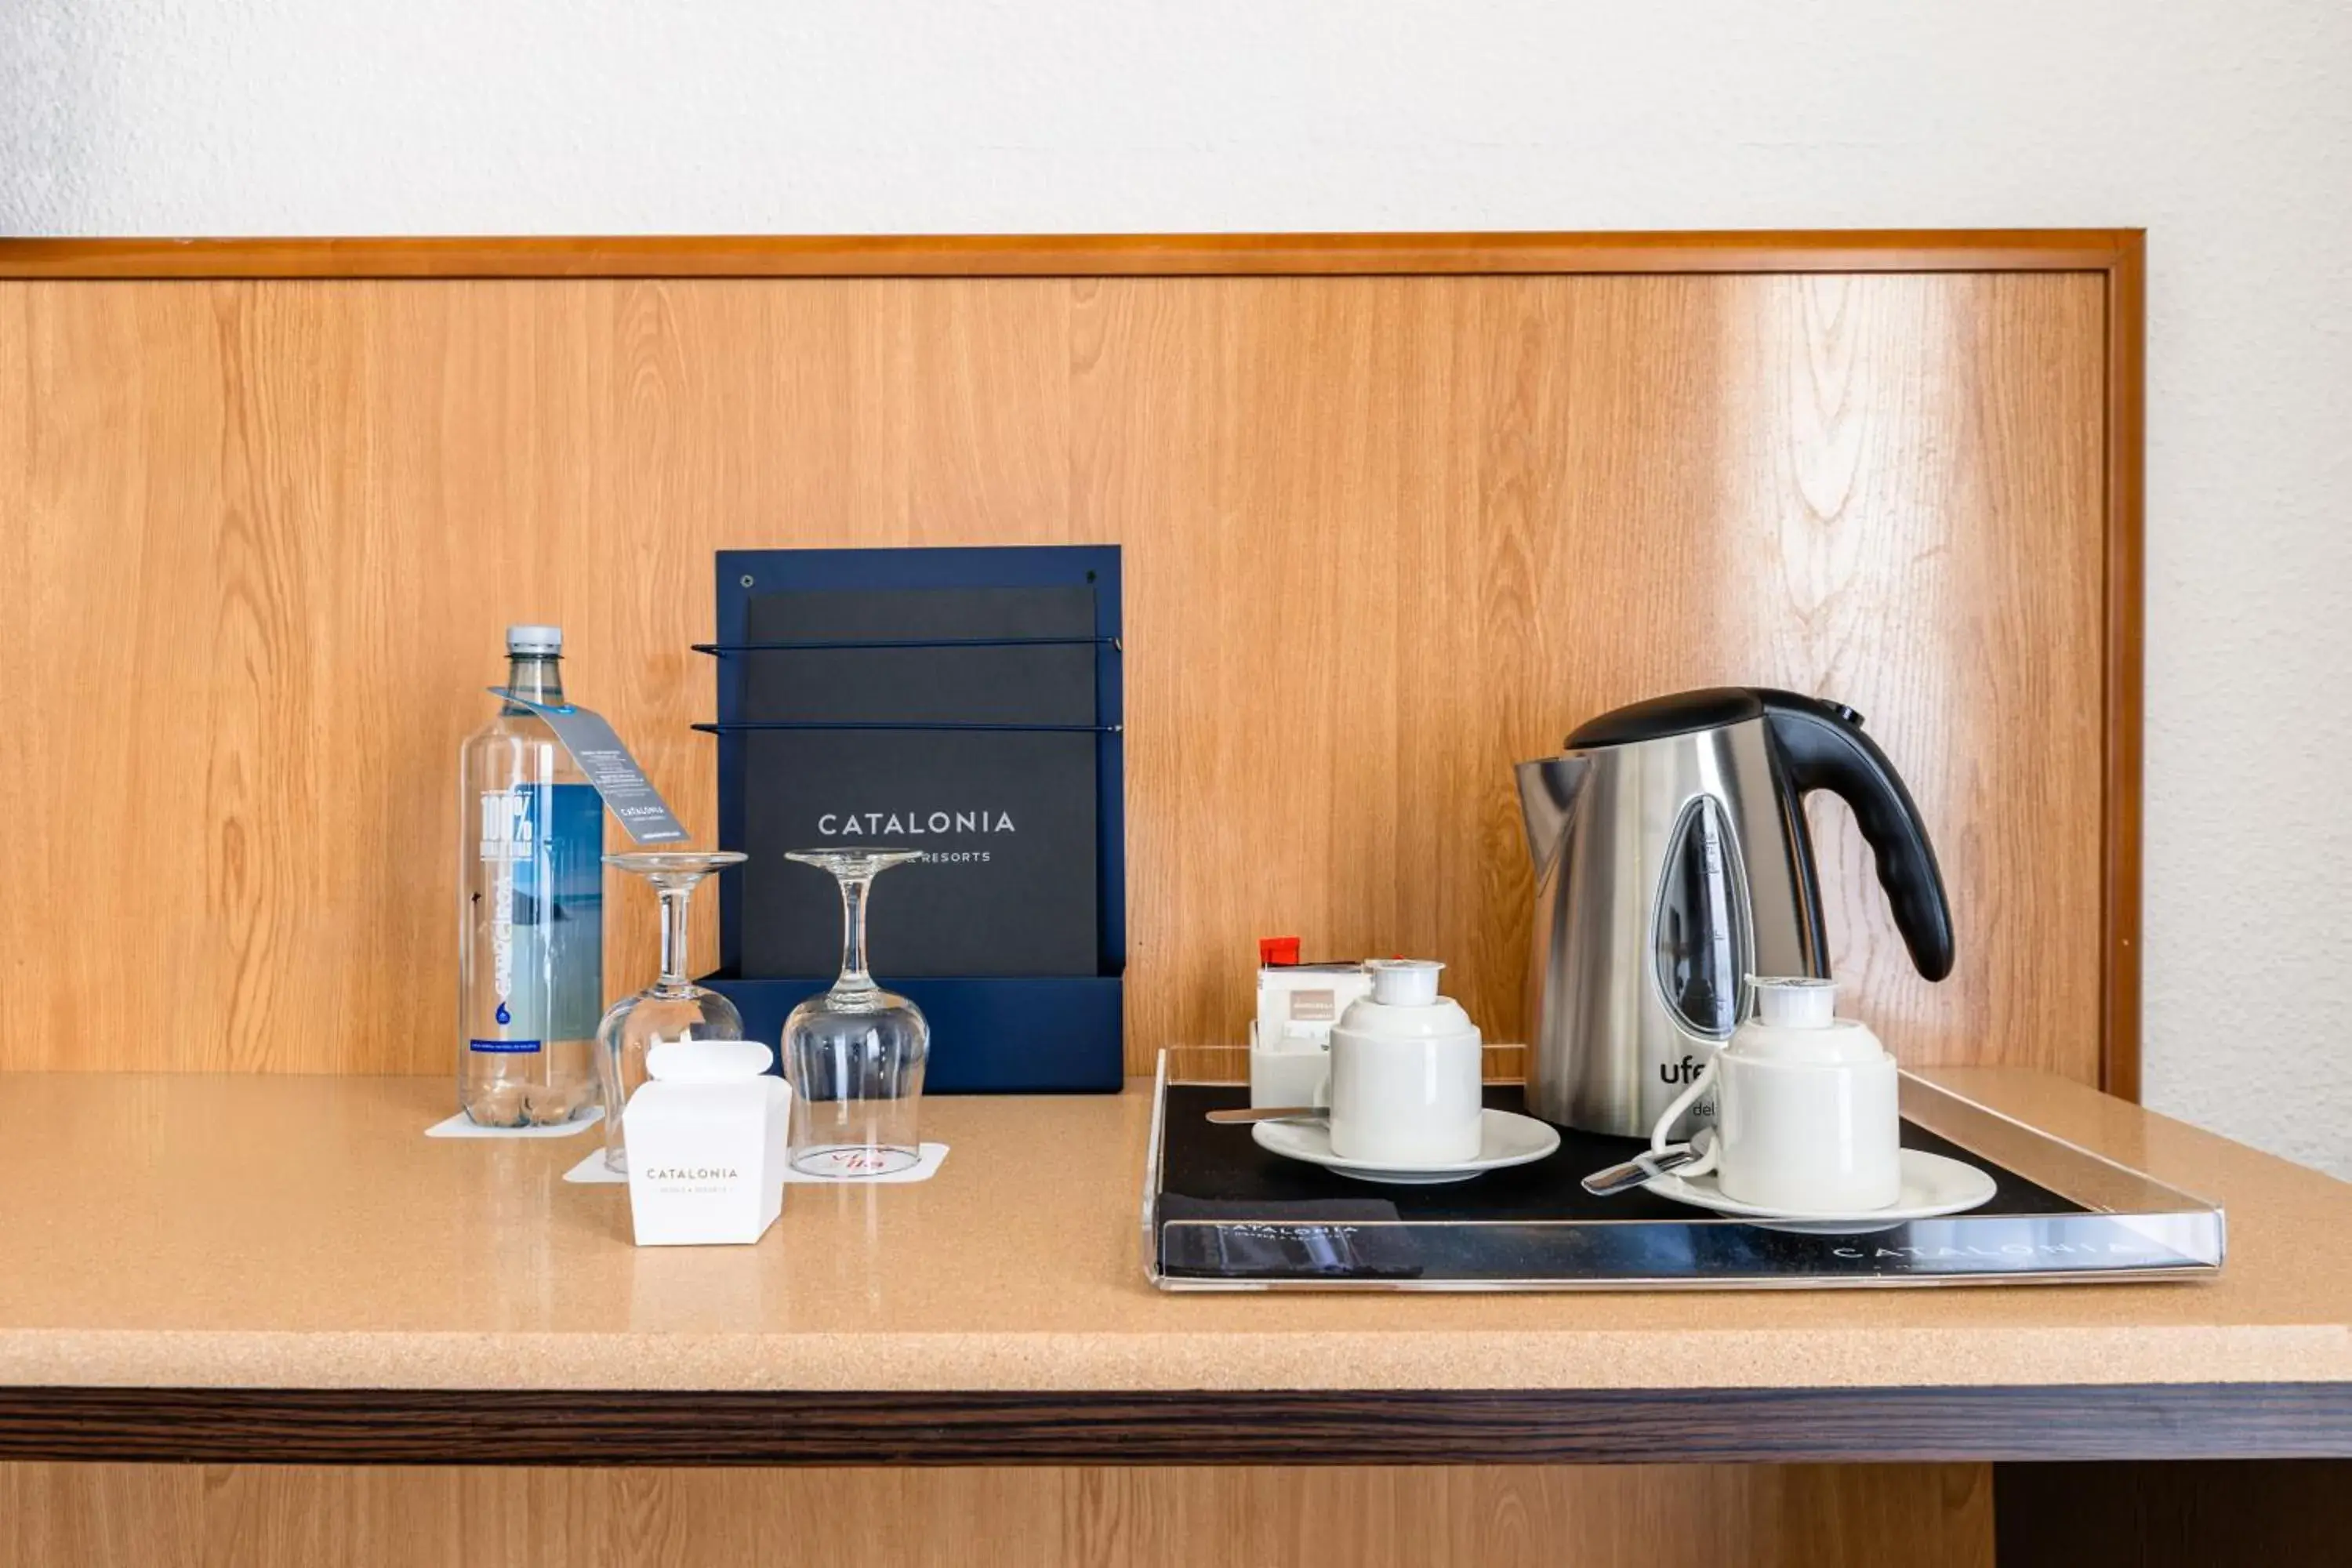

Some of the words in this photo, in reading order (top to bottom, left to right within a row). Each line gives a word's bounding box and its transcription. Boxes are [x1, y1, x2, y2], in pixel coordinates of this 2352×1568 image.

[480, 797, 532, 841] 100%
[818, 811, 1015, 835] CATALONIA
[922, 852, 990, 863] RESORTS
[1660, 1054, 1706, 1084] ufe
[1693, 1102, 1714, 1116] del
[647, 1167, 737, 1179] CATALONIA
